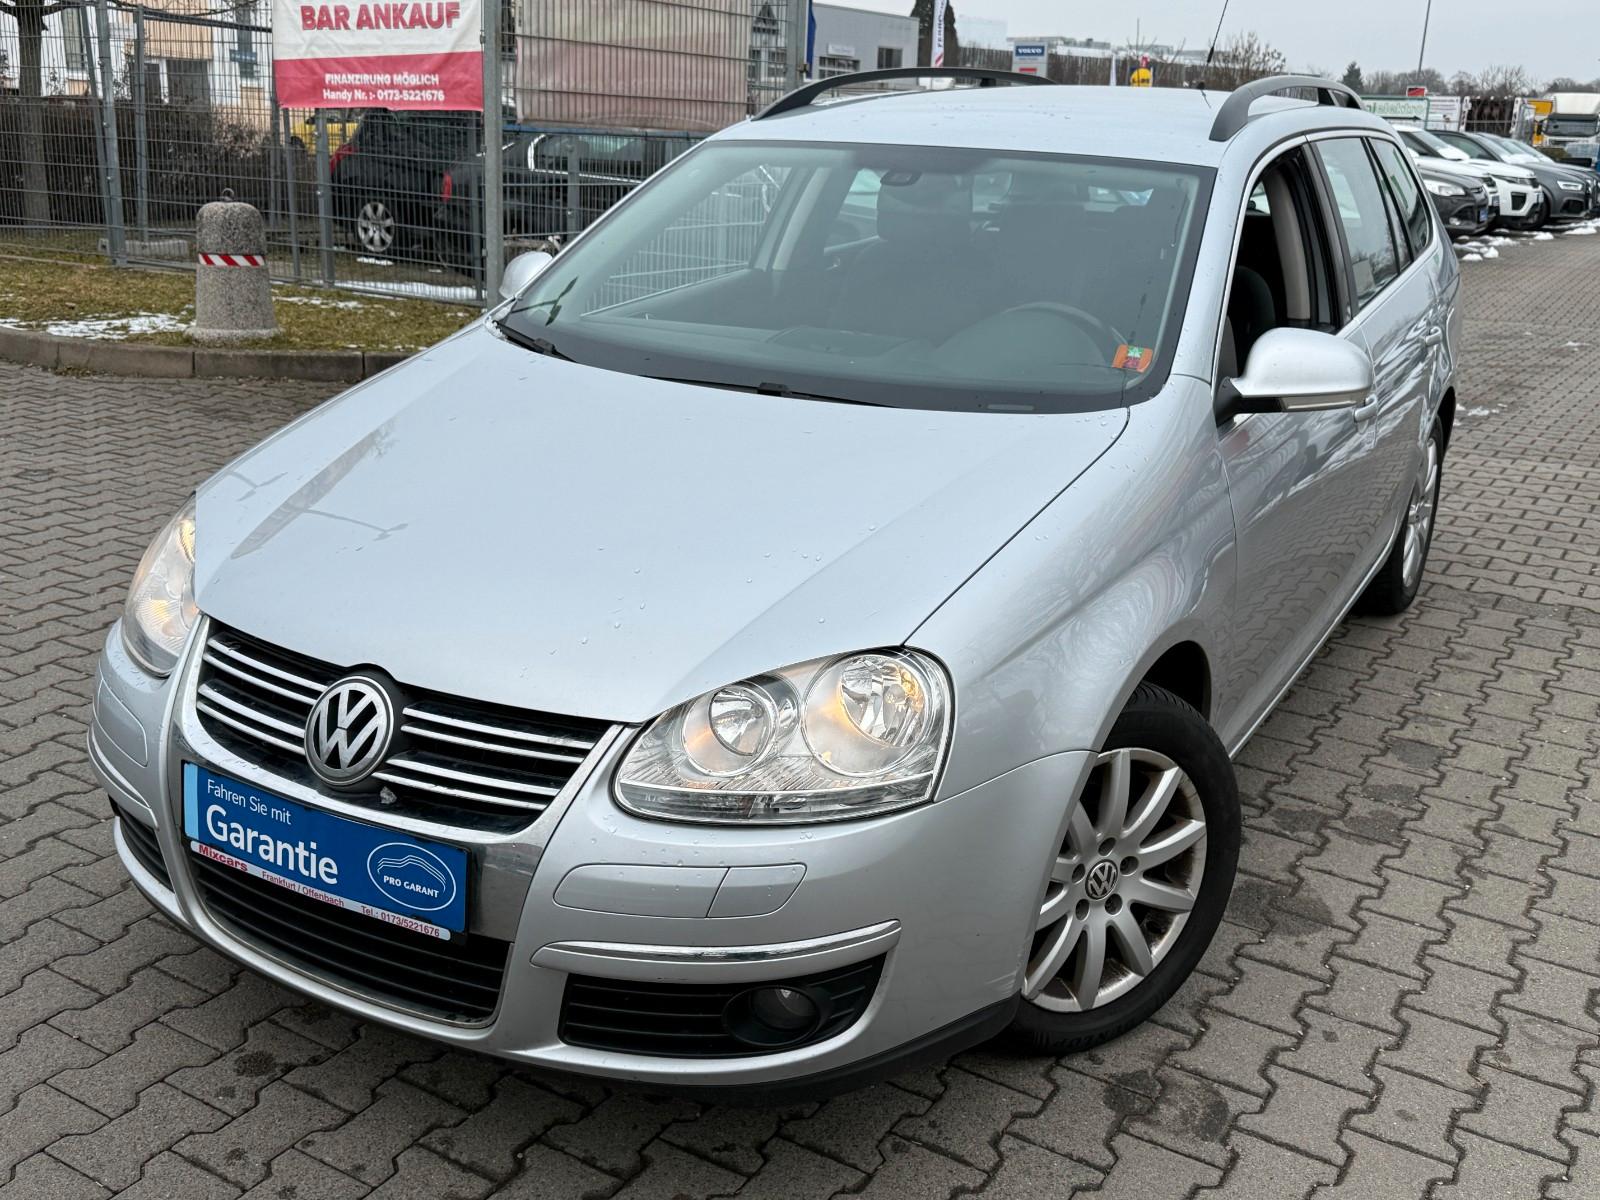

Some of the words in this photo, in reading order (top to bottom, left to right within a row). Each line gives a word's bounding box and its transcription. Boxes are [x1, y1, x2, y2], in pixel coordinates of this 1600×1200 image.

[301, 4, 350, 31] BAR
[356, 1, 461, 30] ANKAUF
[324, 72, 391, 86] FINANZIRUNG
[393, 71, 440, 86] MÖGLICH
[322, 89, 353, 103] Handy
[354, 90, 368, 100] Nr.
[376, 90, 445, 101] 0173-5221676
[207, 779, 247, 808] Fahren
[249, 796, 268, 816] Sie
[271, 807, 292, 825] mit
[198, 844, 248, 873] Mixcars
[206, 804, 339, 885] Garantie
[383, 875, 401, 887] PRO
[404, 880, 440, 899] GARANT
[261, 870, 296, 891] Frankfurt
[302, 886, 345, 907] Offenbach
[380, 911, 440, 938] 0173/5221676
